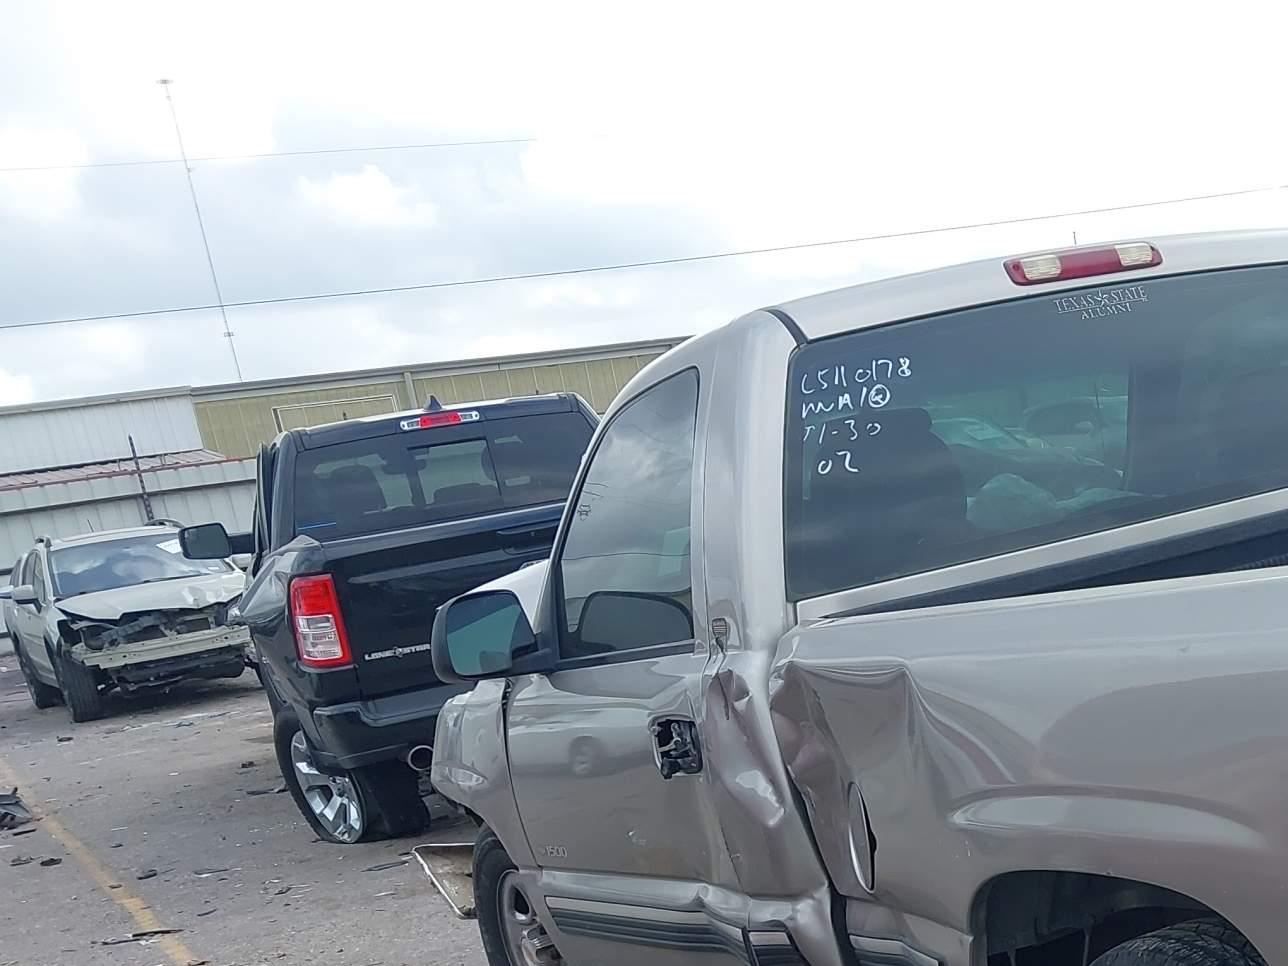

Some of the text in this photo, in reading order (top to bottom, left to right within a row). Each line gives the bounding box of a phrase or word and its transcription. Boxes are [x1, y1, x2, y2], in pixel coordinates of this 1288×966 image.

[1053, 285, 1147, 312] TEXAS STATE
[1080, 302, 1132, 320] ALUMNI
[544, 845, 569, 858] 1500
